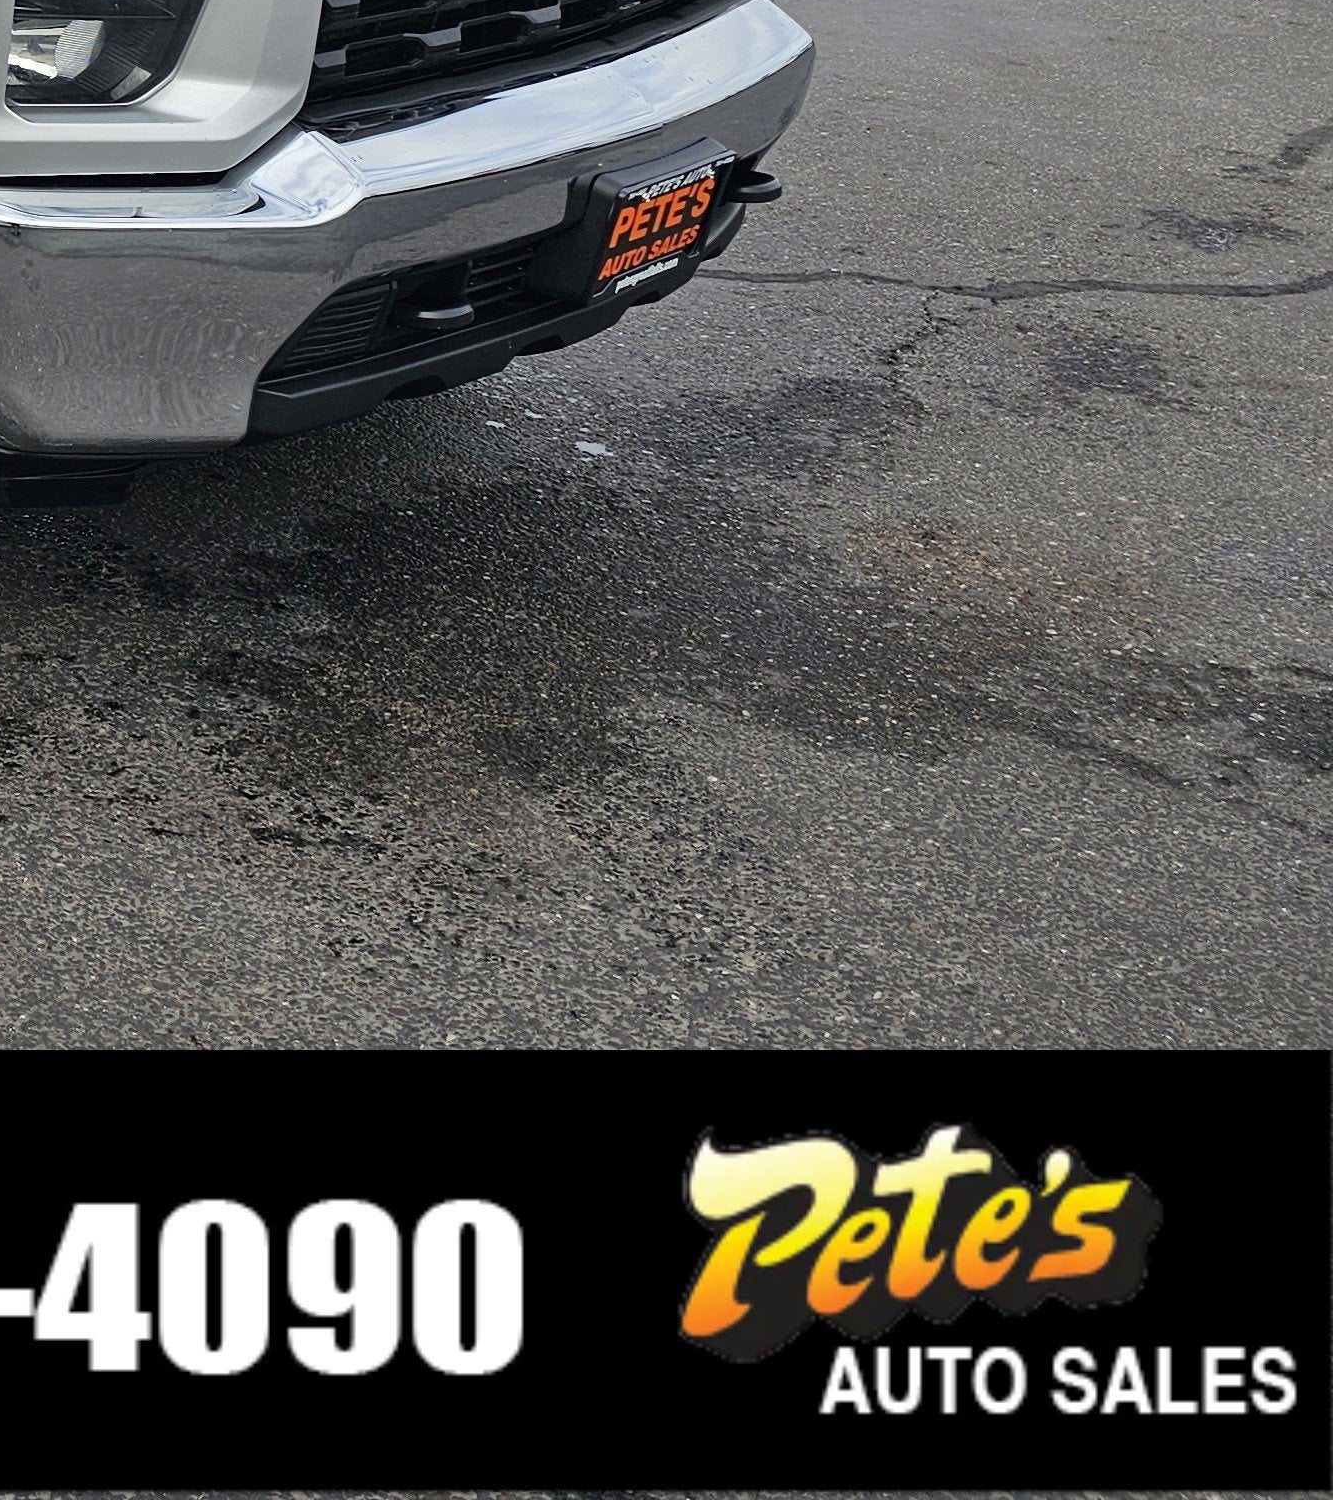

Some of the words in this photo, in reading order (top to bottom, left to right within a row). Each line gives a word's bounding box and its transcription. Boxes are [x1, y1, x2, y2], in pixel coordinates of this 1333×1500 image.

[609, 178, 716, 249] PETE'S
[598, 245, 647, 281] AUTO
[647, 224, 701, 260] SALES
